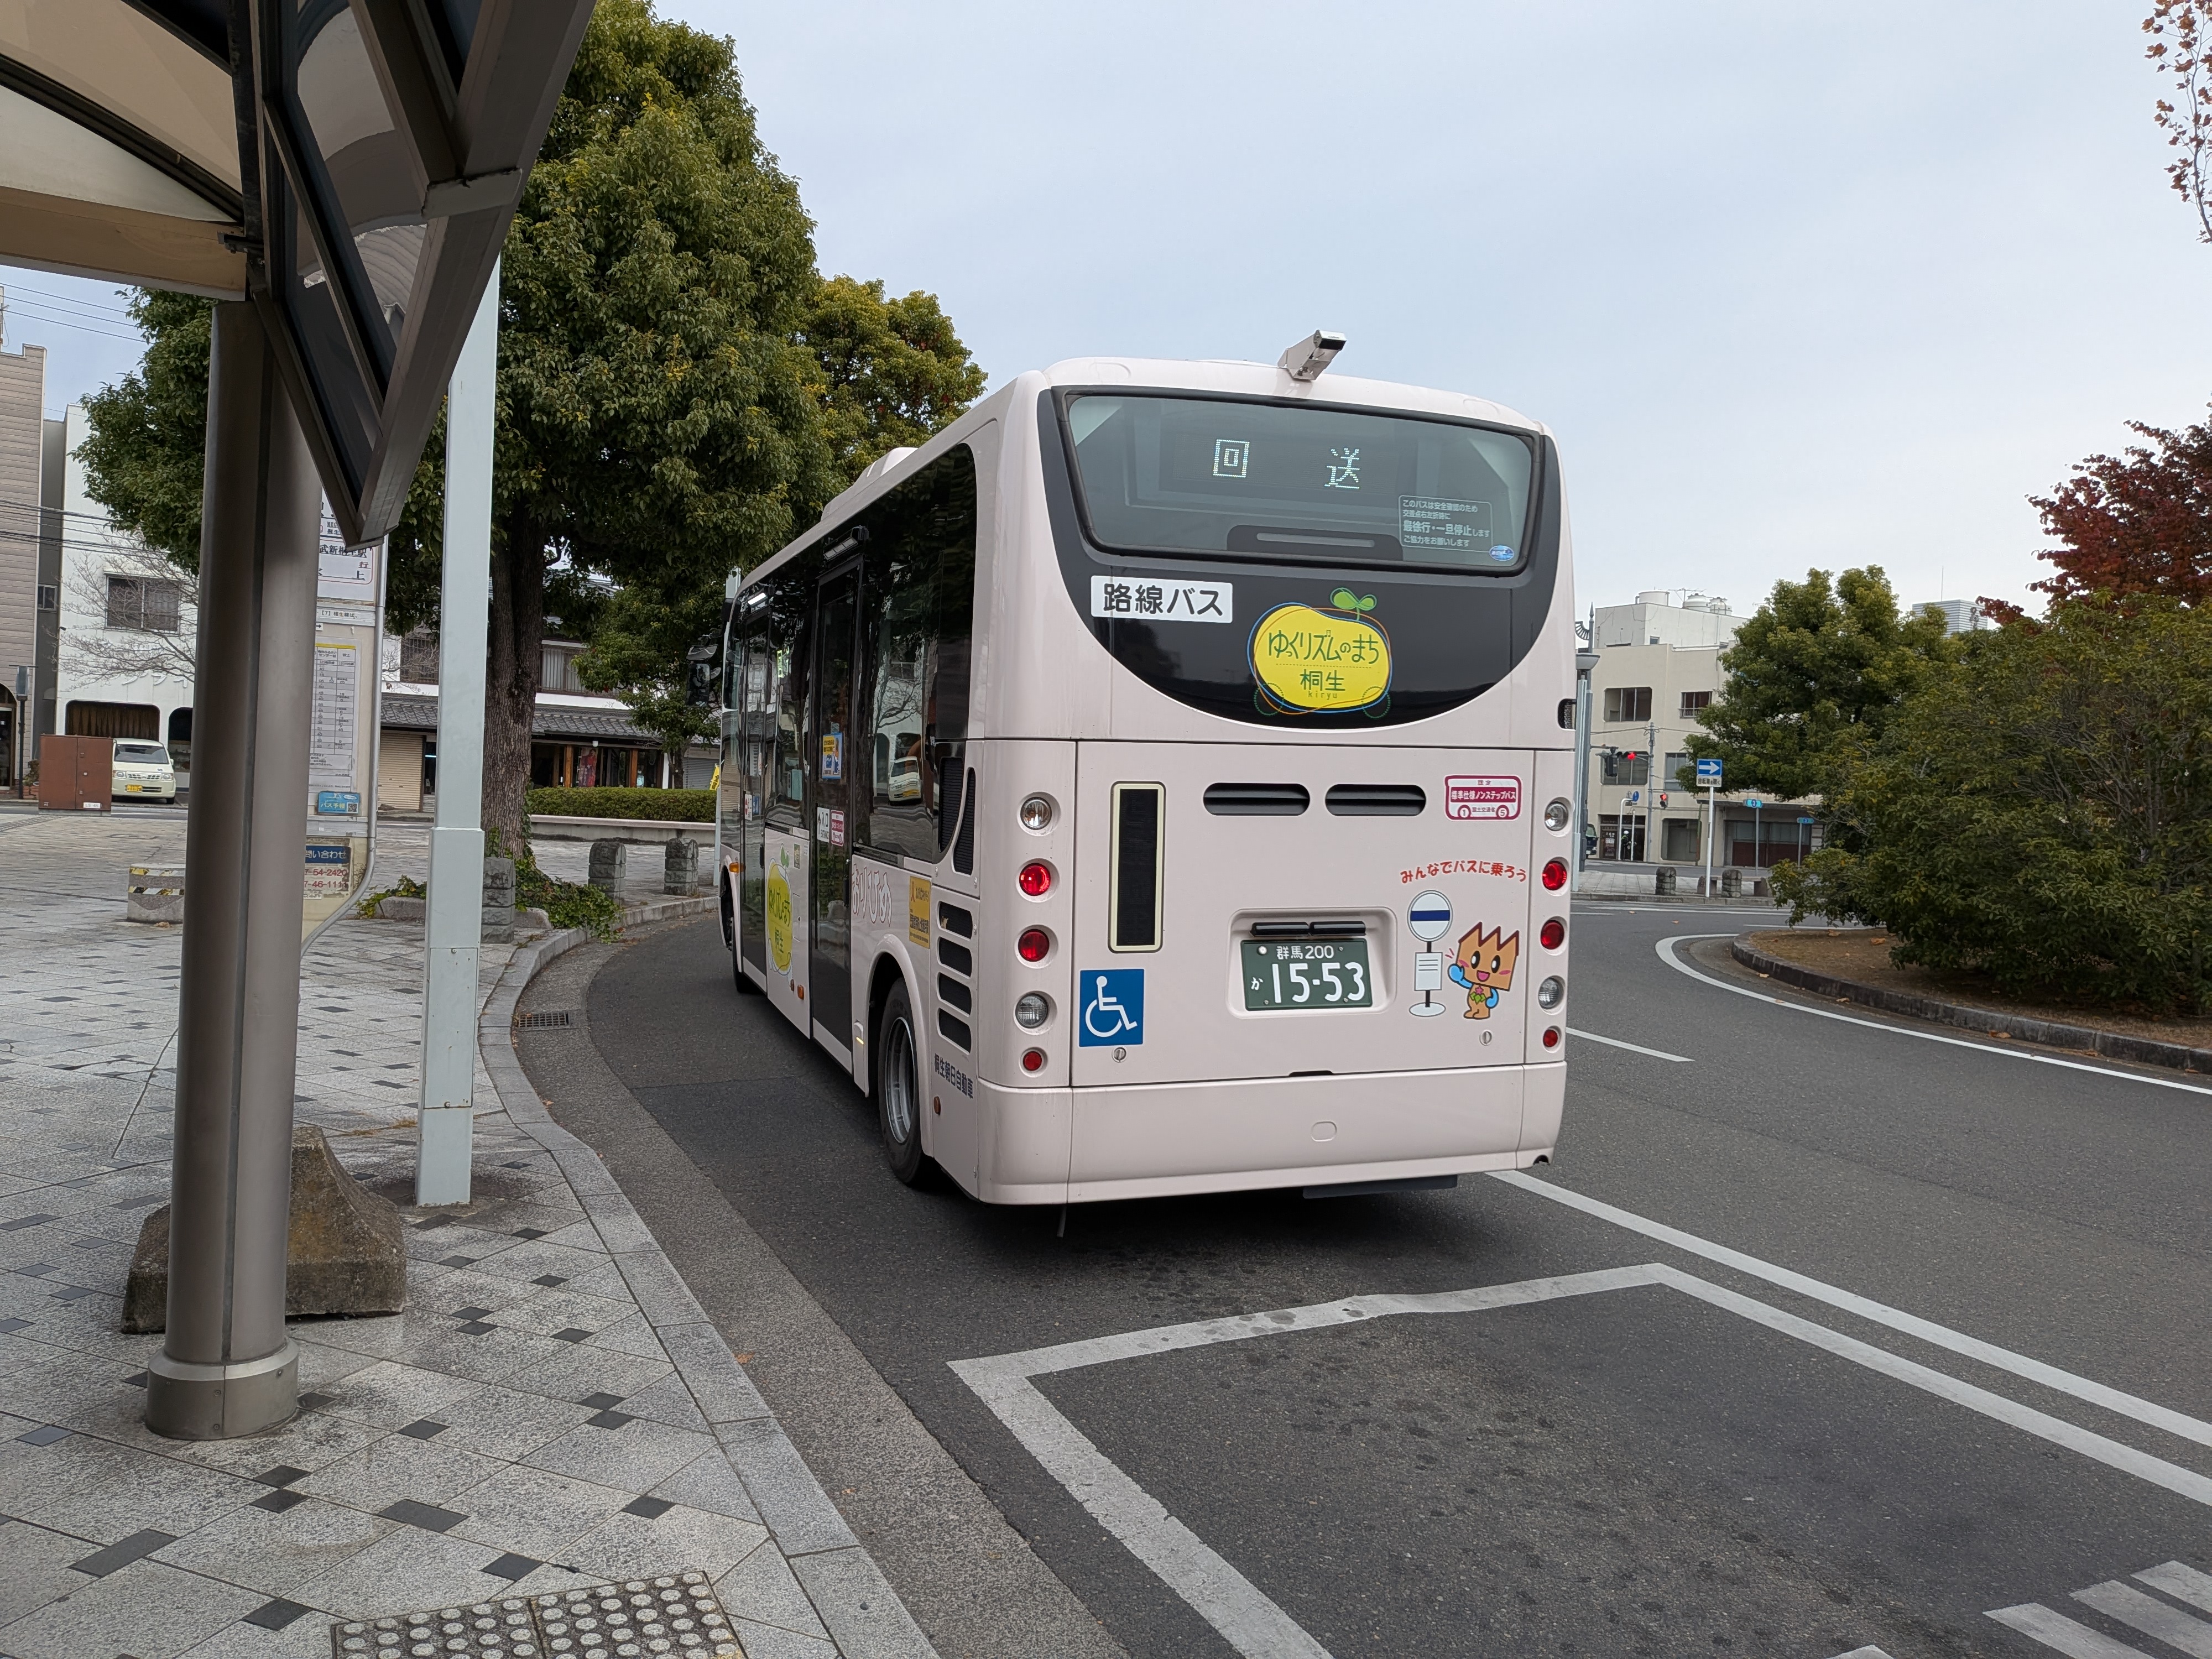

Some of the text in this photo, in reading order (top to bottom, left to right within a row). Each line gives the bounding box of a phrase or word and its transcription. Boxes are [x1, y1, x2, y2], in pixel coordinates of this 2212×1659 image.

[1402, 499, 1478, 513] このバスは安全確認のため
[1404, 535, 1470, 547] ご協力をお願いします
[1103, 583, 1223, 616] 路線バス
[1300, 669, 1345, 691] 桐生
[1308, 691, 1337, 700] kiryu
[1400, 860, 1527, 884] みんなでバスに乗ろう
[852, 864, 892, 927] おりひめ
[1250, 977, 1264, 990] か
[1272, 962, 1365, 1003] 15-53
